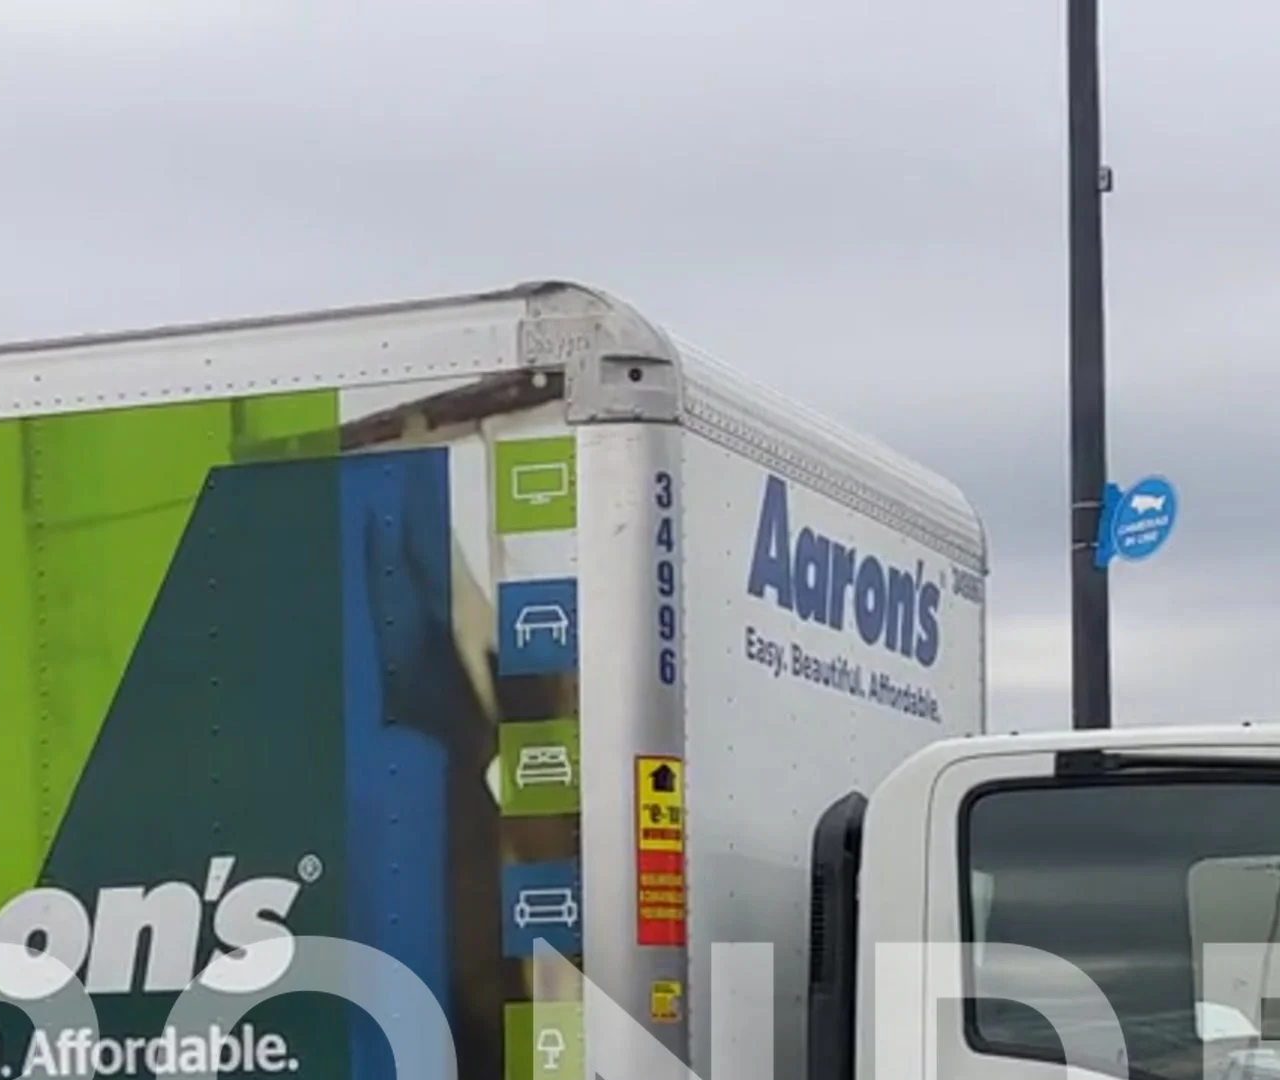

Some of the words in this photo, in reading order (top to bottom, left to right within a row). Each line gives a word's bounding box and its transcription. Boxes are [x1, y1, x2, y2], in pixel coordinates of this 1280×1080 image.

[654, 471, 677, 686] 34996
[747, 474, 941, 667] Aaron's
[745, 625, 788, 679] Easy.
[23, 1025, 300, 1079] Affordable.
